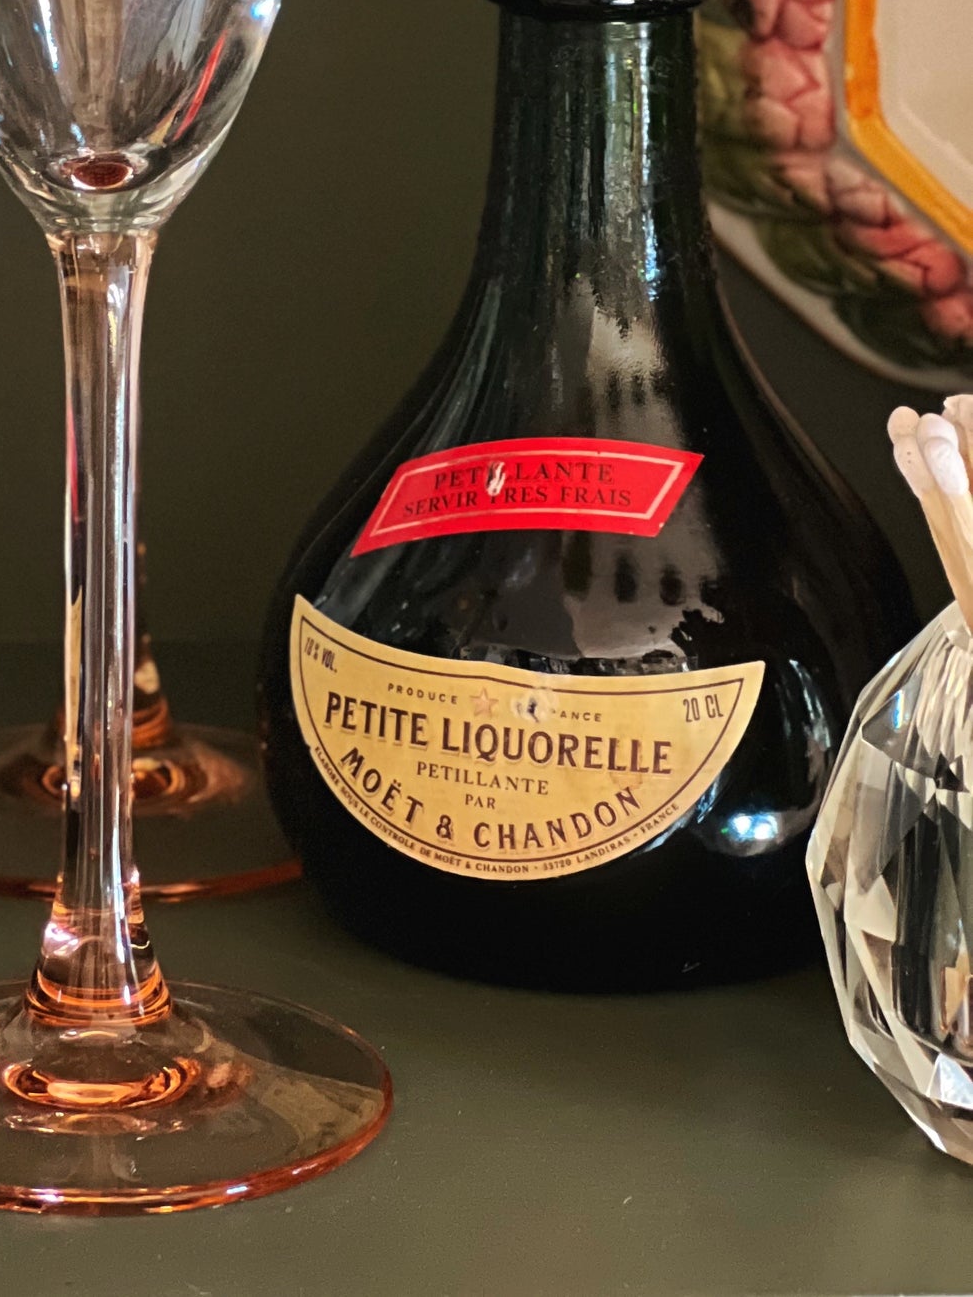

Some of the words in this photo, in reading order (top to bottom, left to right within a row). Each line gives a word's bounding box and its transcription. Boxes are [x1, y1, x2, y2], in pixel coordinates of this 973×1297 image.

[403, 492, 478, 518] SERVIR
[560, 486, 632, 507] FRAIS
[388, 683, 458, 704] PRODUCE
[683, 697, 700, 723] 20
[705, 694, 724, 719] CL
[324, 691, 429, 748] PETITE
[442, 717, 672, 775] LIQUORELLE
[417, 761, 549, 795] PETILLANTE
[340, 747, 424, 824] MOËT
[435, 814, 453, 840] &
[473, 786, 641, 850] CHANDON
[464, 793, 496, 809] PAR
[359, 806, 369, 819] LE
[370, 816, 415, 850] CONTROLE
[420, 847, 432, 857] DE
[475, 862, 529, 873] CHANDON
[576, 835, 631, 864] LANDIRAS
[640, 803, 679, 835] FRANCE
